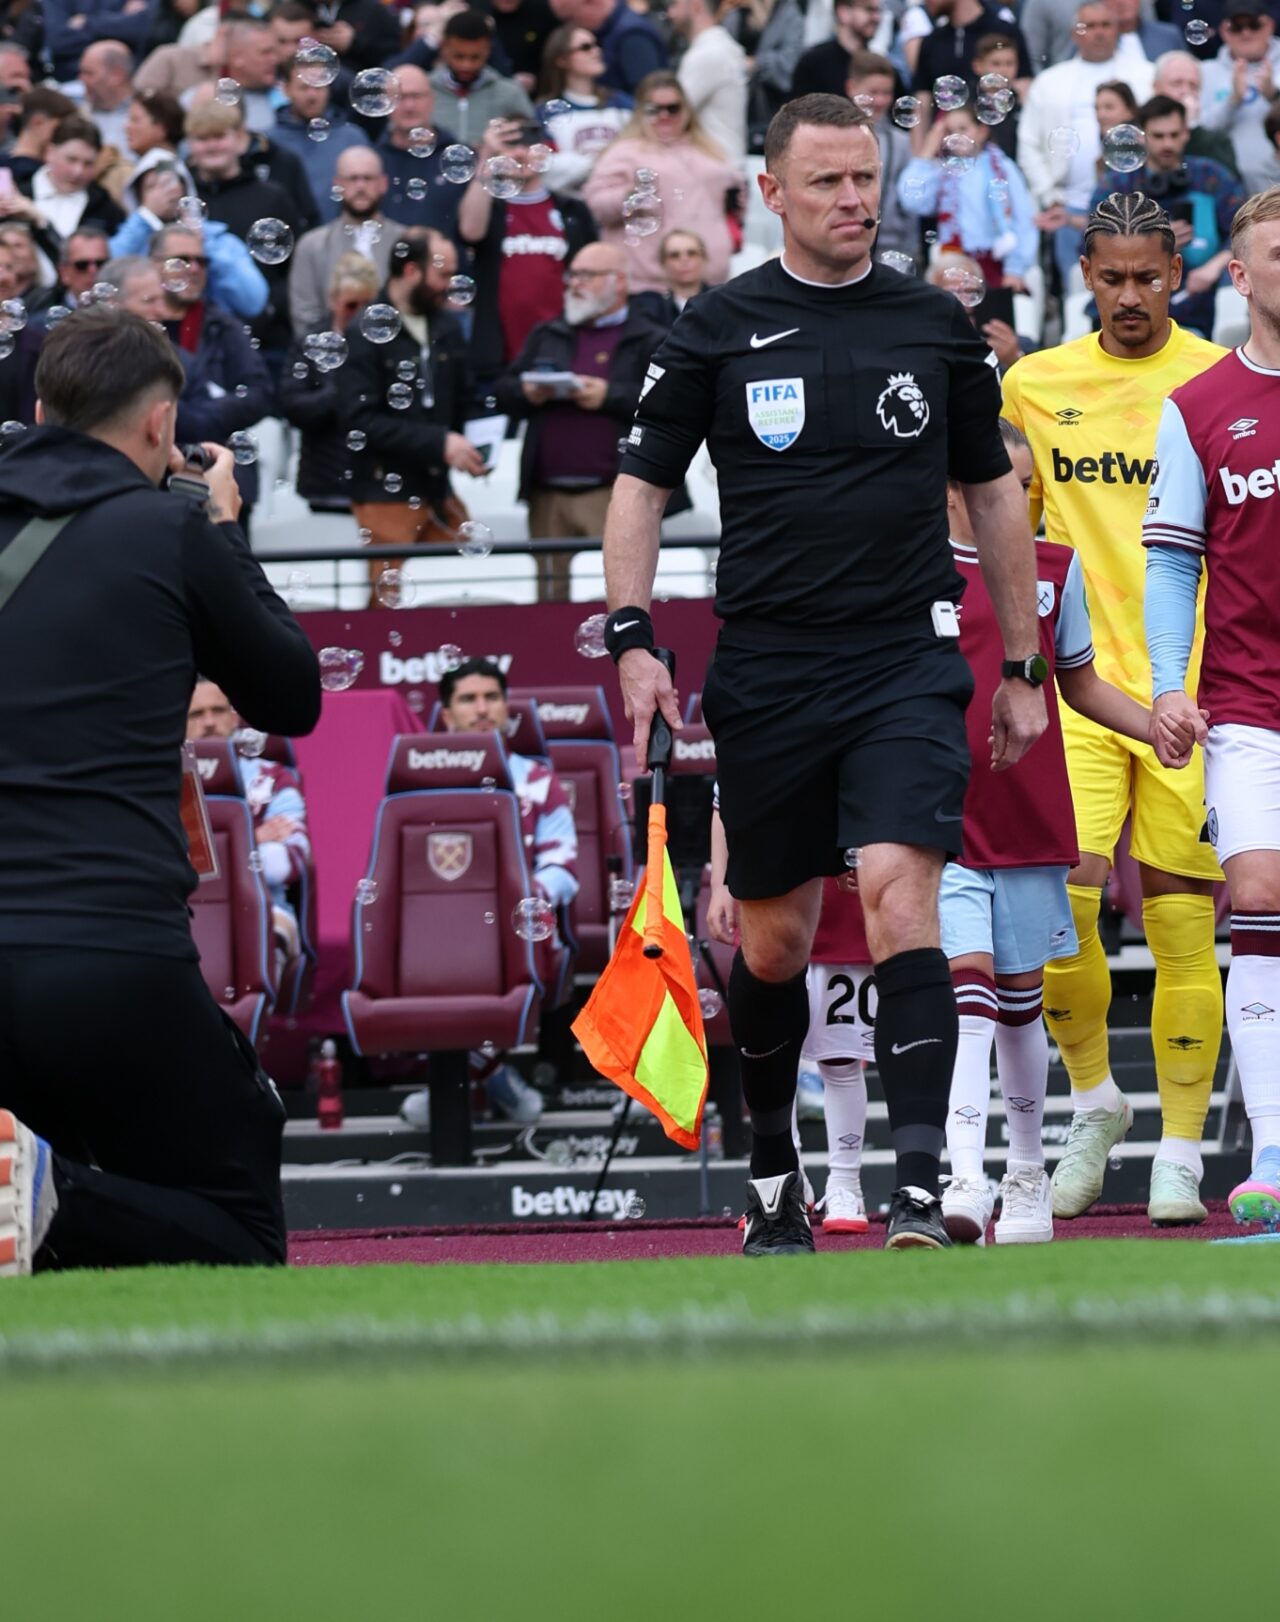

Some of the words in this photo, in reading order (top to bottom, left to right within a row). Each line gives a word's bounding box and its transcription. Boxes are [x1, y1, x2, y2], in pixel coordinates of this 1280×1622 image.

[502, 234, 569, 261] etway
[752, 384, 798, 403] FIFA
[754, 407, 799, 418] ASSISTANT
[758, 416, 796, 426] REFEREE
[768, 434, 790, 445] 2025
[1233, 429, 1256, 440] umbro
[1051, 447, 1154, 484] betw
[408, 748, 487, 772] betway
[674, 739, 716, 760] bet
[826, 973, 880, 1027] 20
[511, 1185, 637, 1221] betway
